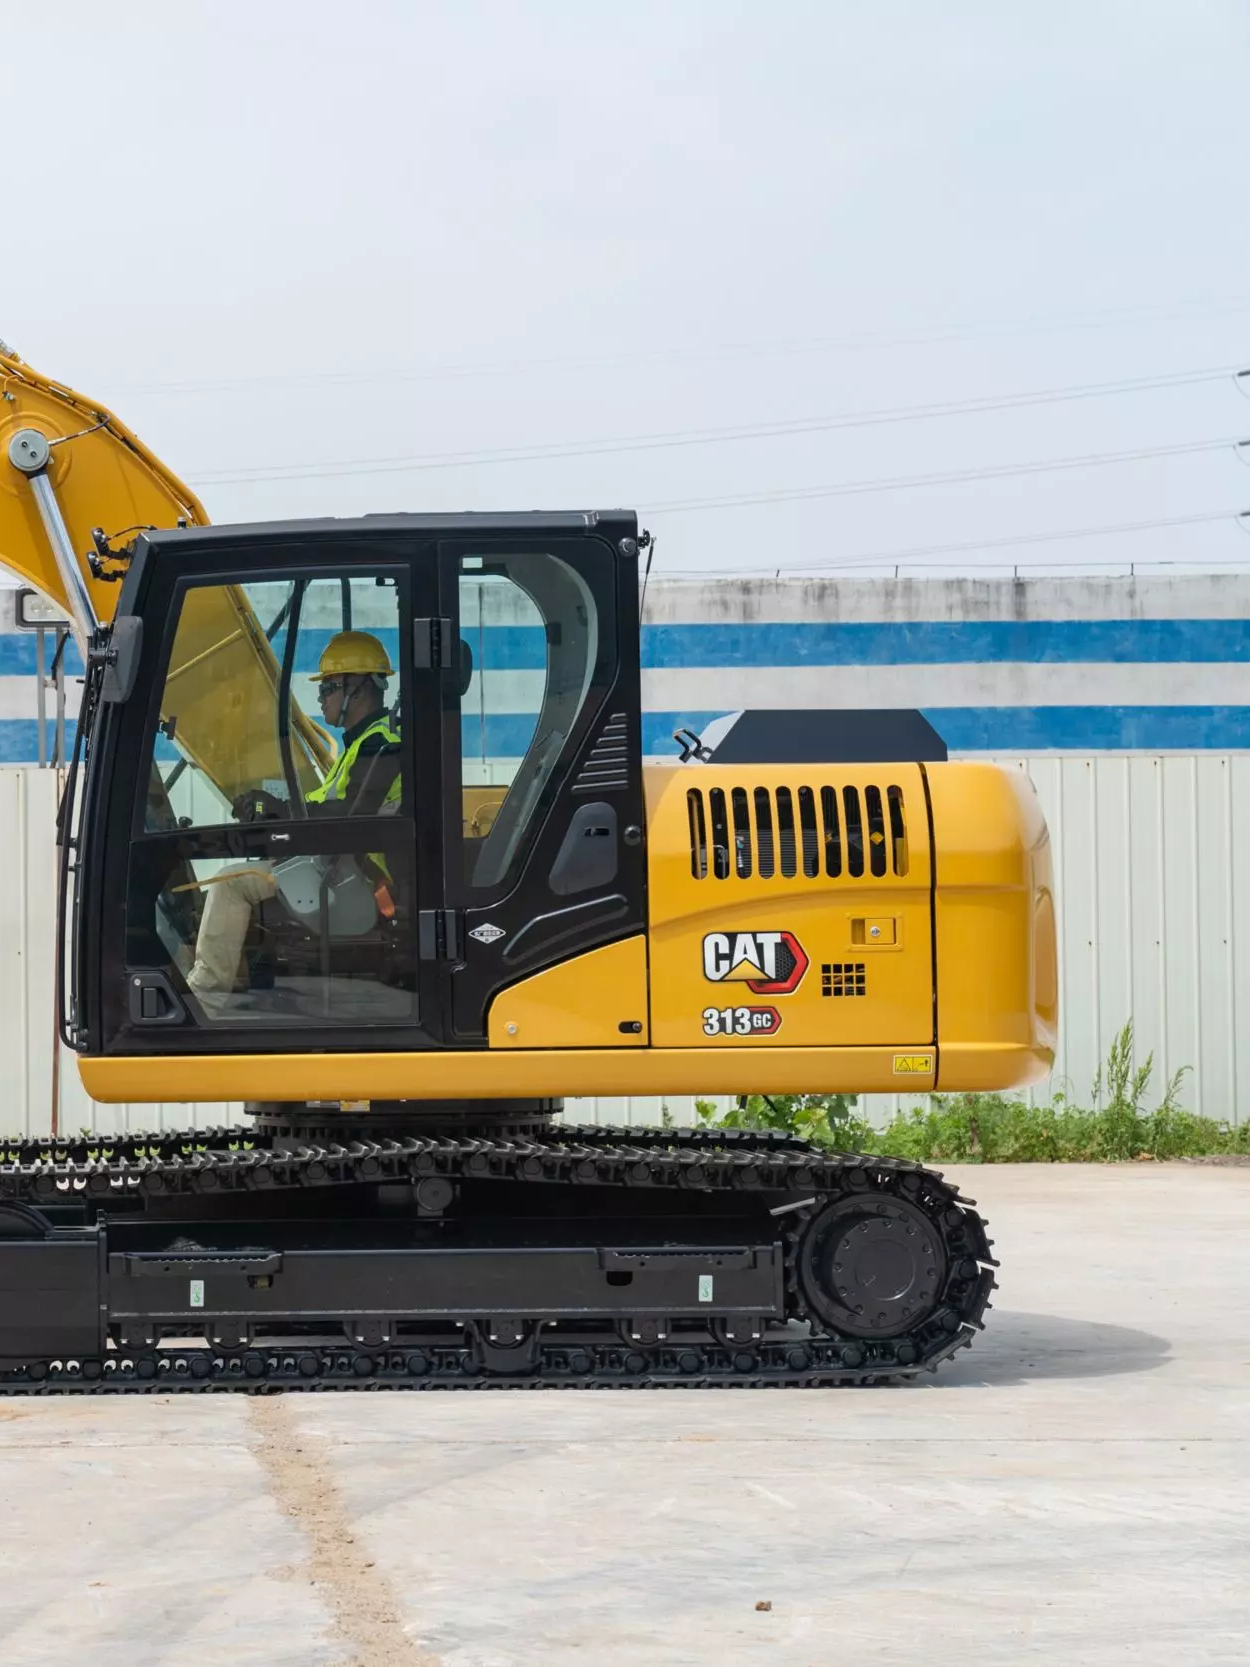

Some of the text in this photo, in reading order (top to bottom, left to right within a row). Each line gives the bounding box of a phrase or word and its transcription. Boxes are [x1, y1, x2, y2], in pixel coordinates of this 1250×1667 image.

[704, 933, 782, 980] CAT
[703, 1007, 772, 1035] 313 GC
